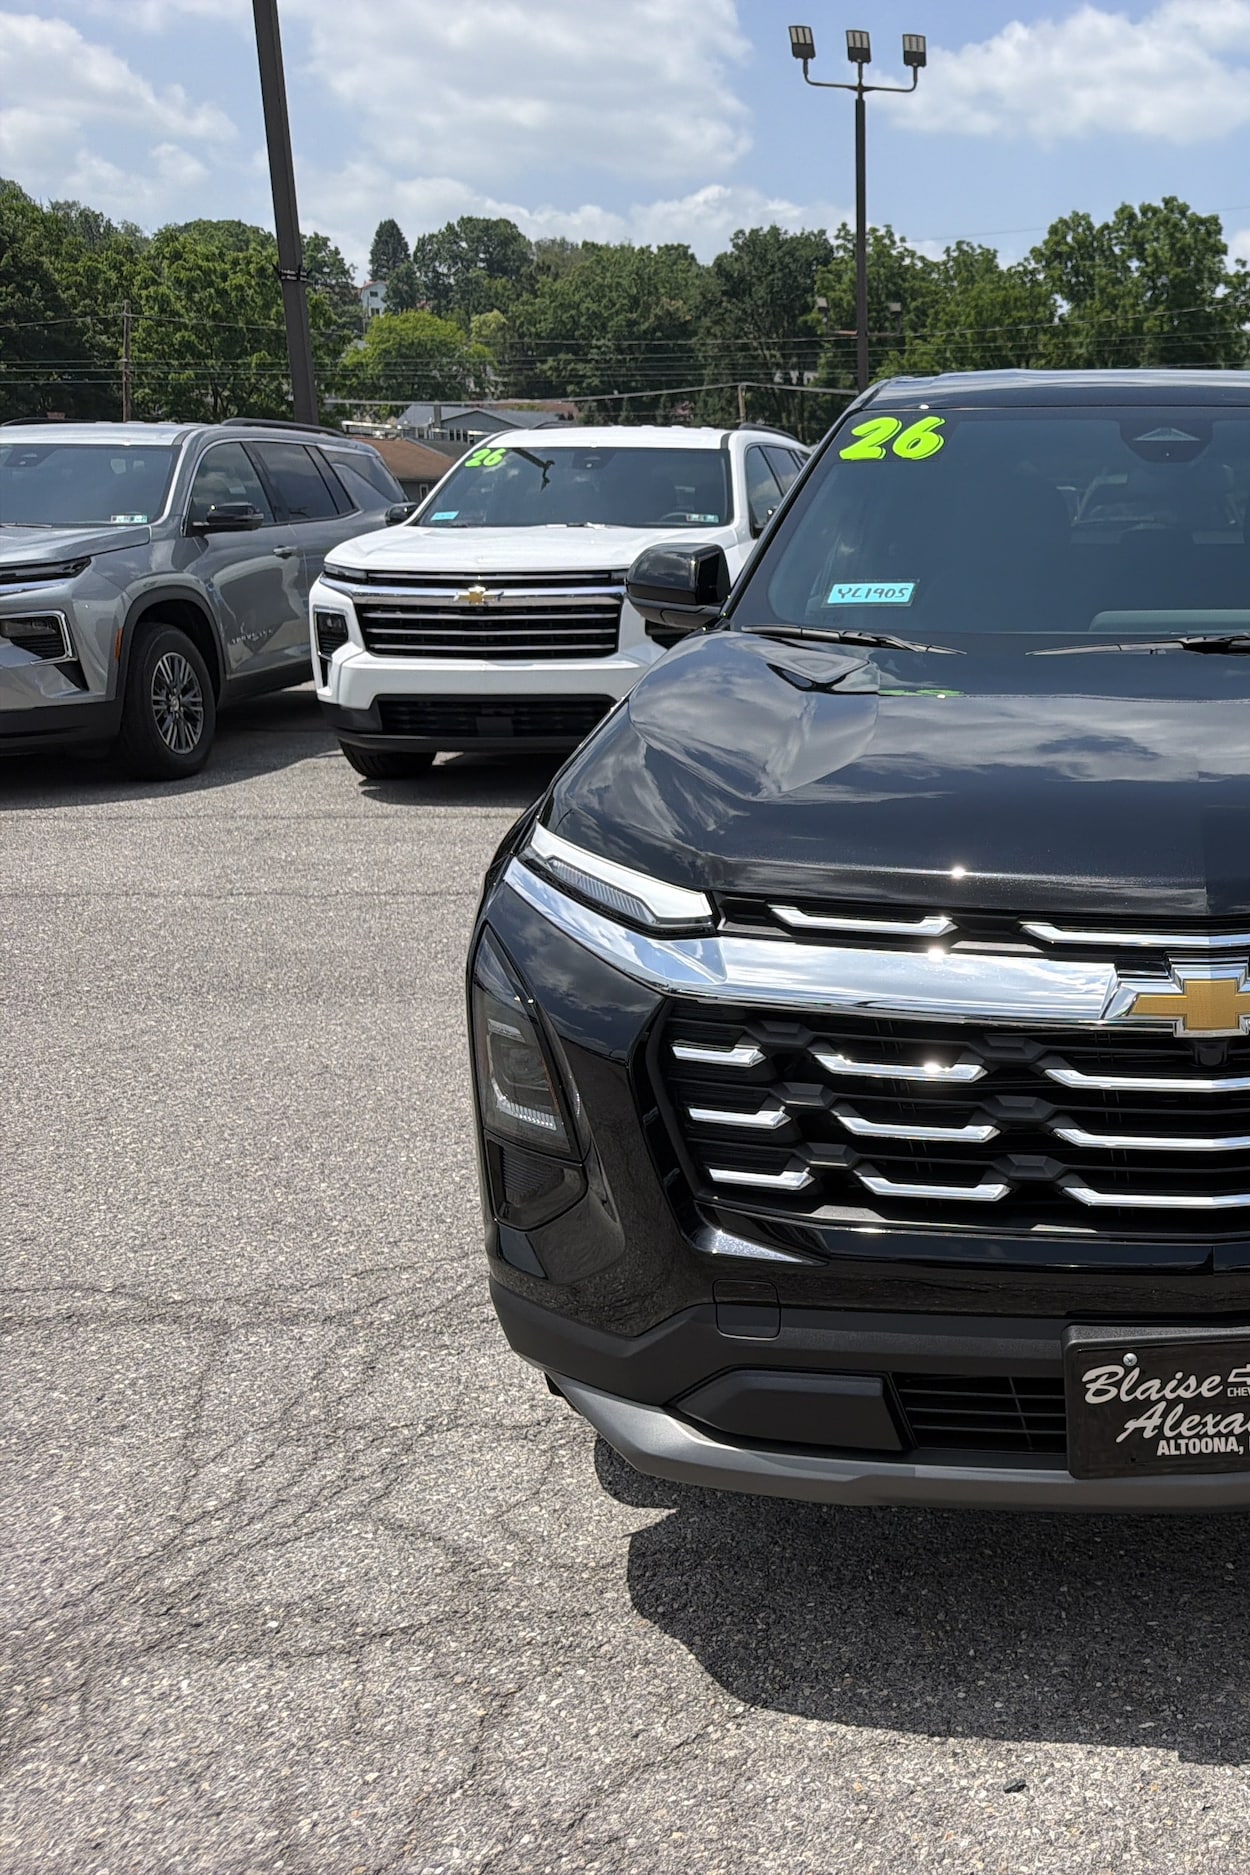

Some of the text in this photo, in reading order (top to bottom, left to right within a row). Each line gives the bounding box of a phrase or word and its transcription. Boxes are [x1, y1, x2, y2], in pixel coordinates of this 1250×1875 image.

[839, 416, 946, 460] 26
[464, 448, 506, 467] 26
[1082, 1365, 1223, 1404] Blaise
[1157, 1436, 1244, 1455] ALTOONA,
